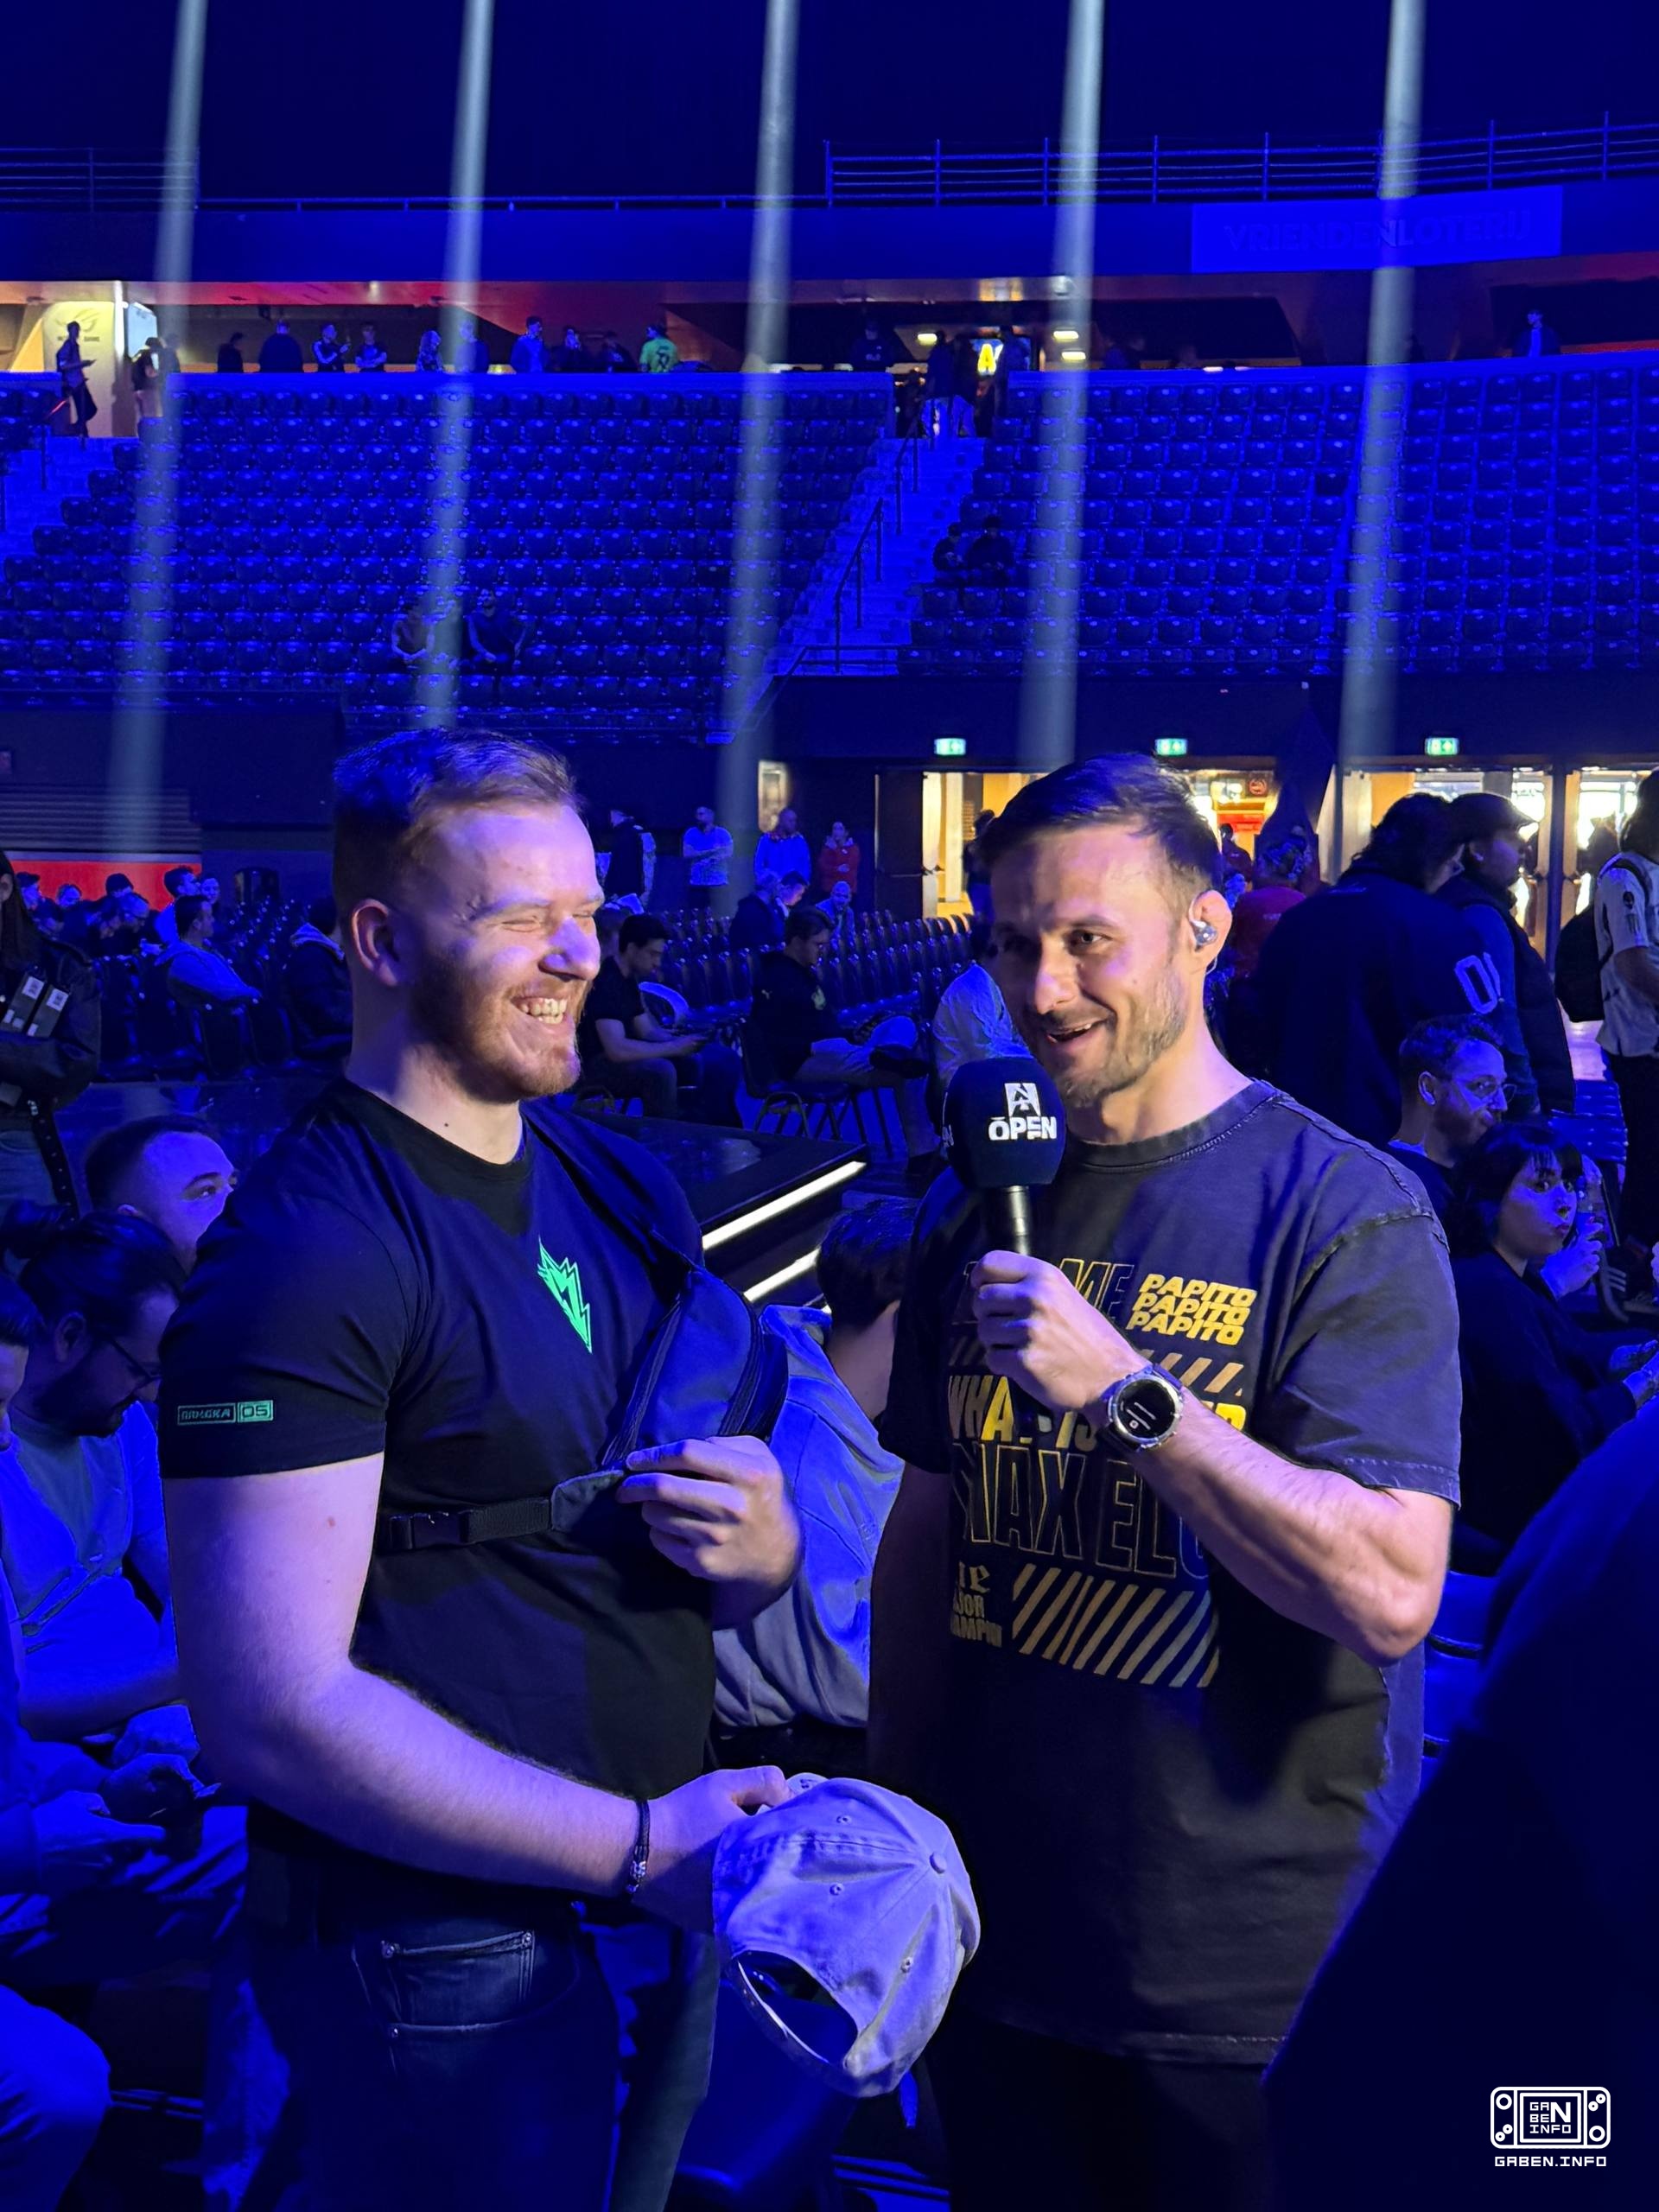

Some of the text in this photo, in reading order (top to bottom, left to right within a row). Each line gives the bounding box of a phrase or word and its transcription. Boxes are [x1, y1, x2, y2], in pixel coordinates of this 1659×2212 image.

[1224, 210, 1531, 251] VRIENDENLOTERIJ
[1139, 1274, 1257, 1307] PAPITO
[1132, 1293, 1250, 1325] PAPITO
[1125, 1311, 1244, 1345] PAPITO
[948, 1375, 1033, 1444] WHA
